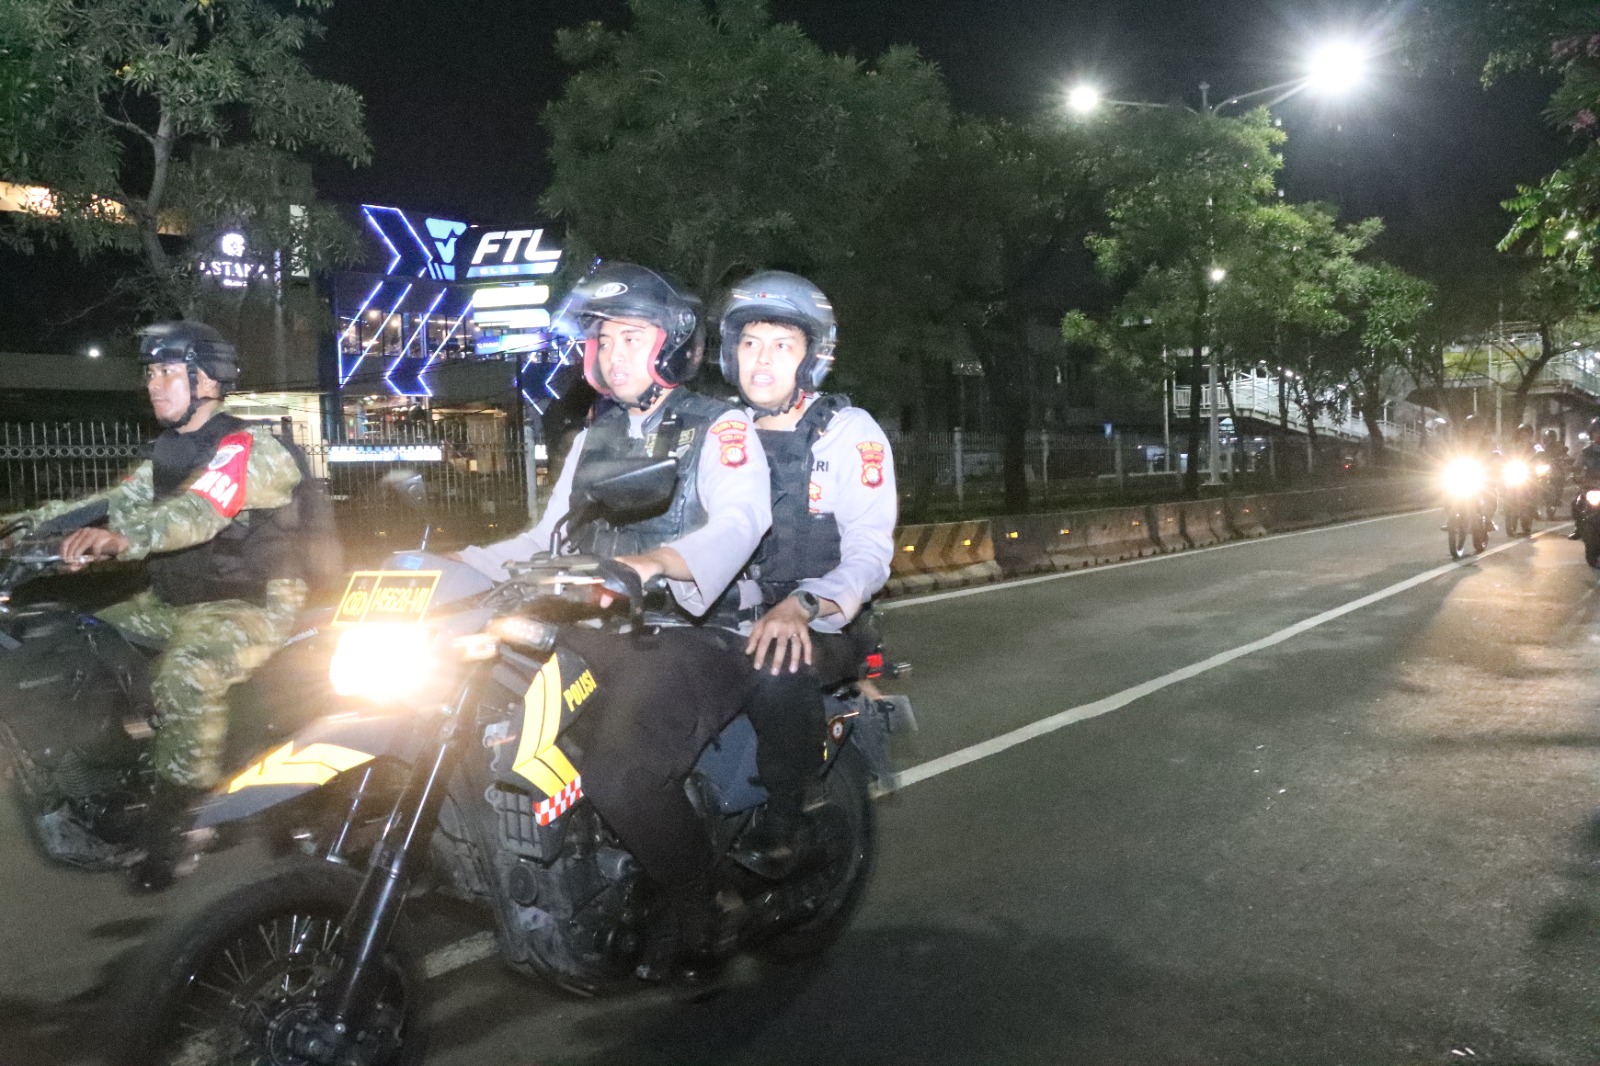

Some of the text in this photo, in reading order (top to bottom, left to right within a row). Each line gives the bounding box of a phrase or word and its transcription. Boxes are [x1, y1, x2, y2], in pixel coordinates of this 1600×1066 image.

[471, 229, 562, 264] FTL
[811, 460, 829, 472] RI
[562, 668, 597, 712] POLISI
